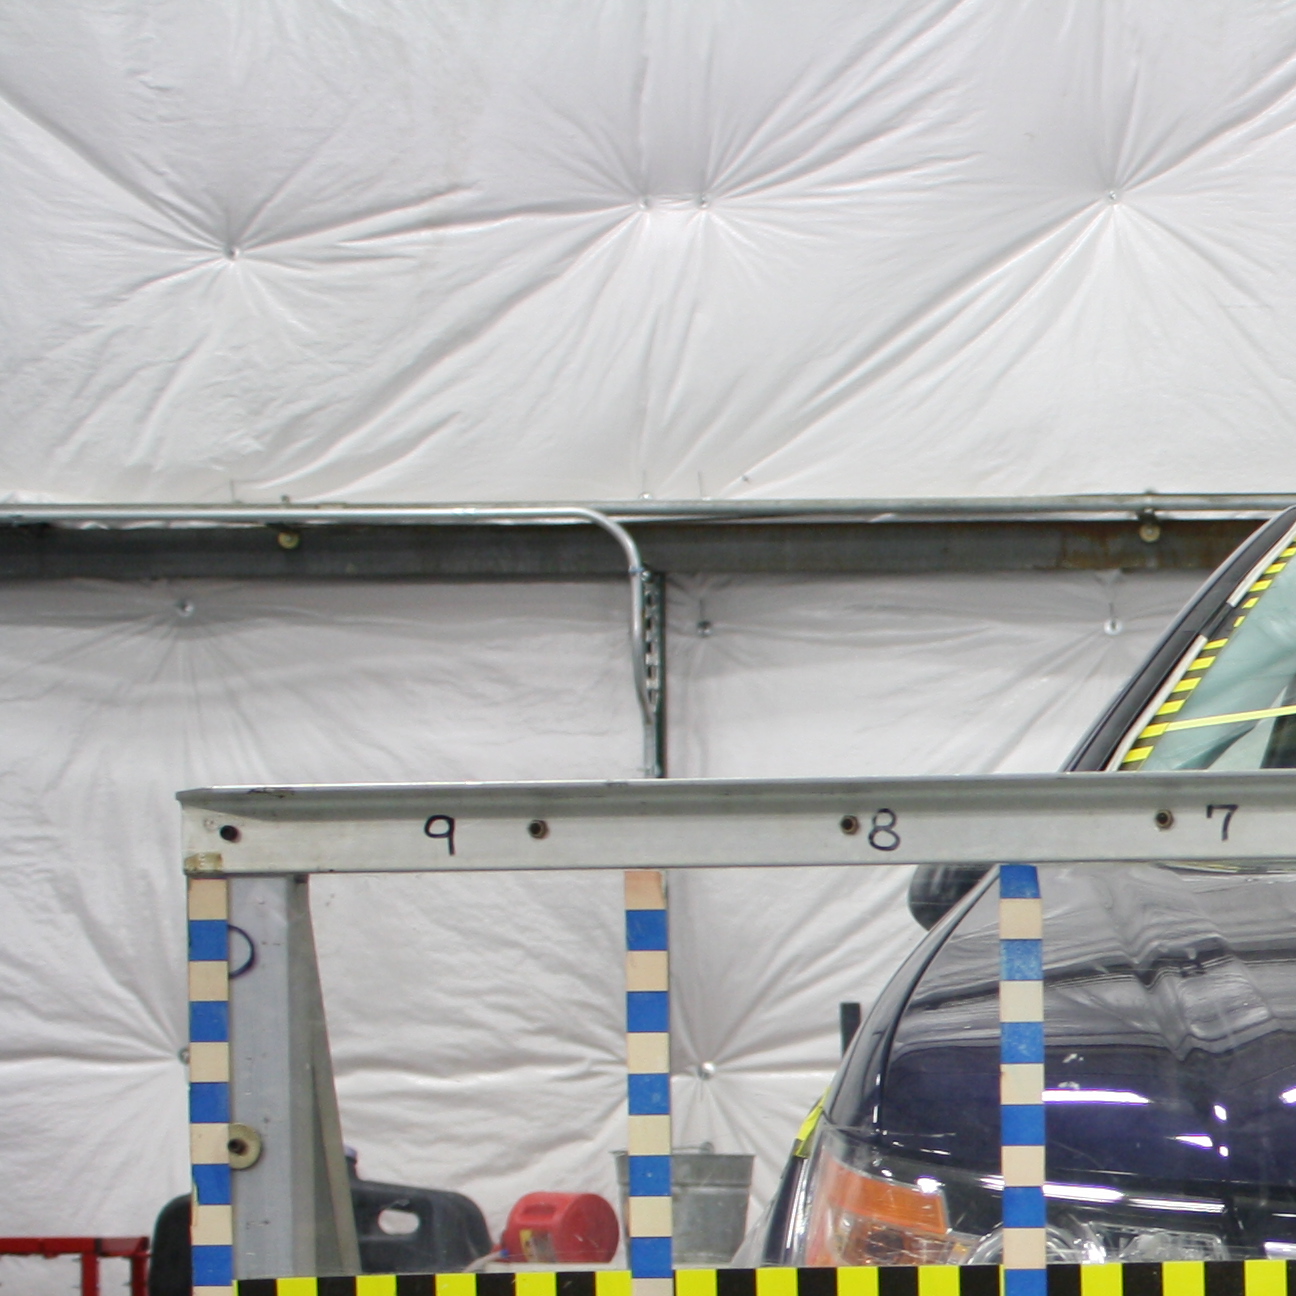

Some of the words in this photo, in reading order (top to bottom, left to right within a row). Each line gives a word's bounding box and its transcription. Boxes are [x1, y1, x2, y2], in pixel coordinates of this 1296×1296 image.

[425, 814, 456, 856] 9
[868, 808, 900, 852] 8
[1205, 803, 1239, 842] 7
